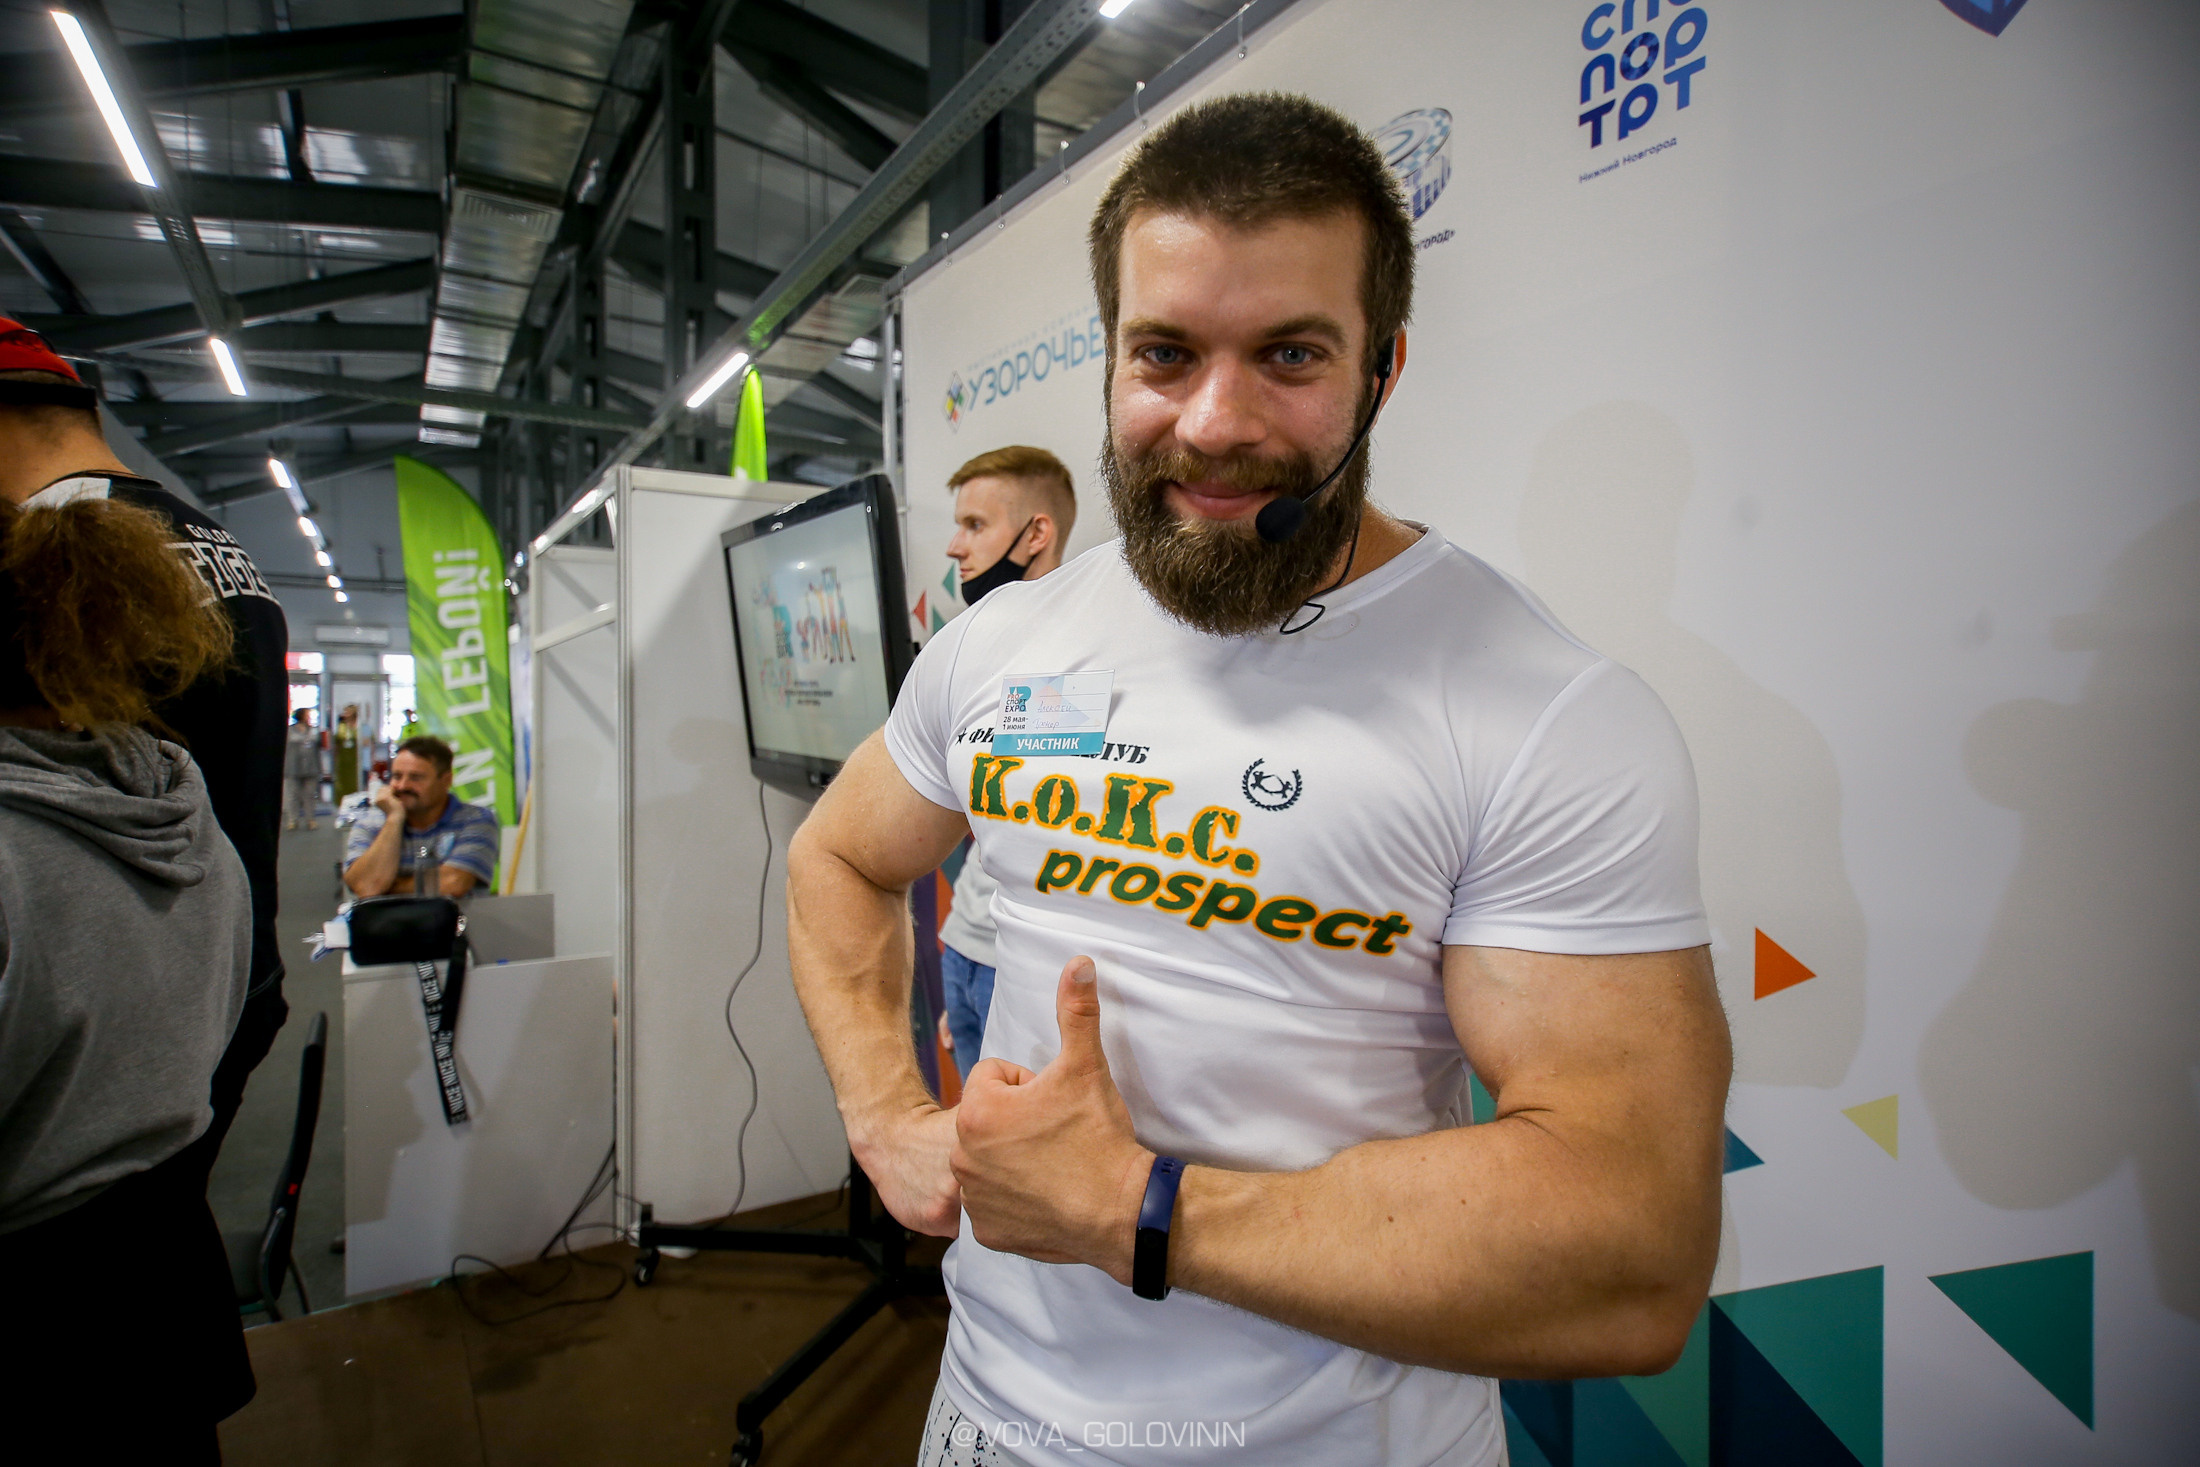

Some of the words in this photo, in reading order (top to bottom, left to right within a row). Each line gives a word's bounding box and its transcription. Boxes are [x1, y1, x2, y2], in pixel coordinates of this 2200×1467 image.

[1578, 159, 1621, 184] Нижний
[1622, 137, 1678, 167] Новгород
[967, 314, 1105, 412] УЗОРОЧЬЕ
[185, 523, 240, 544] GOLDE
[1004, 705, 1027, 713] EXPO
[968, 727, 995, 744] ФИ
[1016, 737, 1080, 751] УЧАСТНИК
[1035, 848, 1414, 957] prospect
